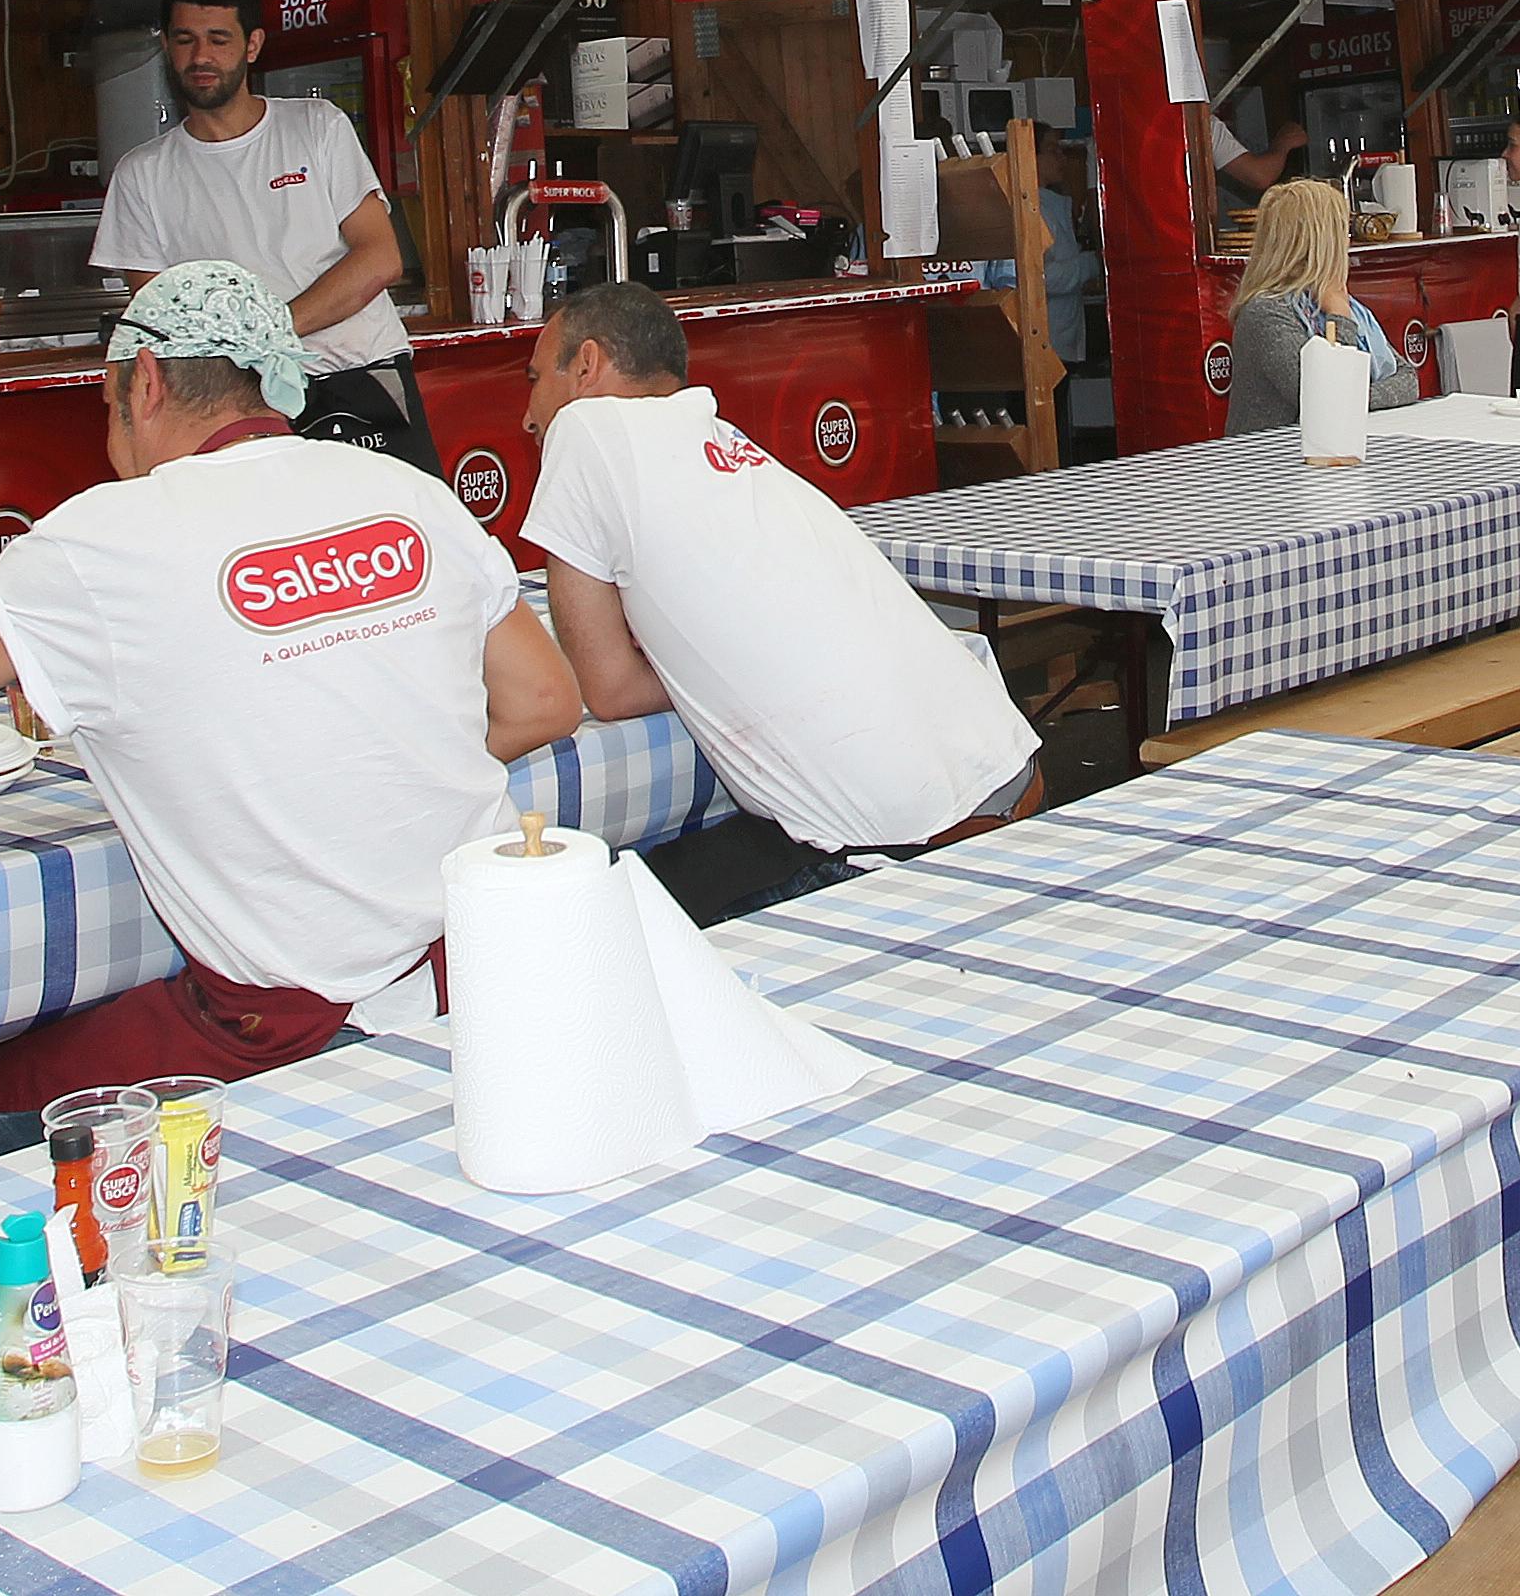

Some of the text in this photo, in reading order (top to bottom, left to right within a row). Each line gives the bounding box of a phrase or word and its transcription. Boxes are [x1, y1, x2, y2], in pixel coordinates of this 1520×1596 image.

[281, 1, 329, 31] BOCK
[1448, 4, 1496, 23] SUPER
[1327, 31, 1392, 60] SAGRES
[272, 173, 306, 190] IDEAL
[543, 186, 597, 198] SUPER BOCK
[1407, 342, 1425, 354] BOCK
[1208, 356, 1231, 369] SUPER
[1210, 367, 1230, 379] BOCK
[819, 418, 851, 435] SUPER
[821, 431, 851, 448] BOCK
[460, 469, 500, 489] SUPER
[462, 484, 499, 504] BOCK
[233, 534, 418, 614] Salsiçor
[261, 606, 439, 664] A QUALIDADE DOS AÇORES
[101, 1172, 139, 1192] SUPER
[104, 1184, 137, 1202] BOCK
